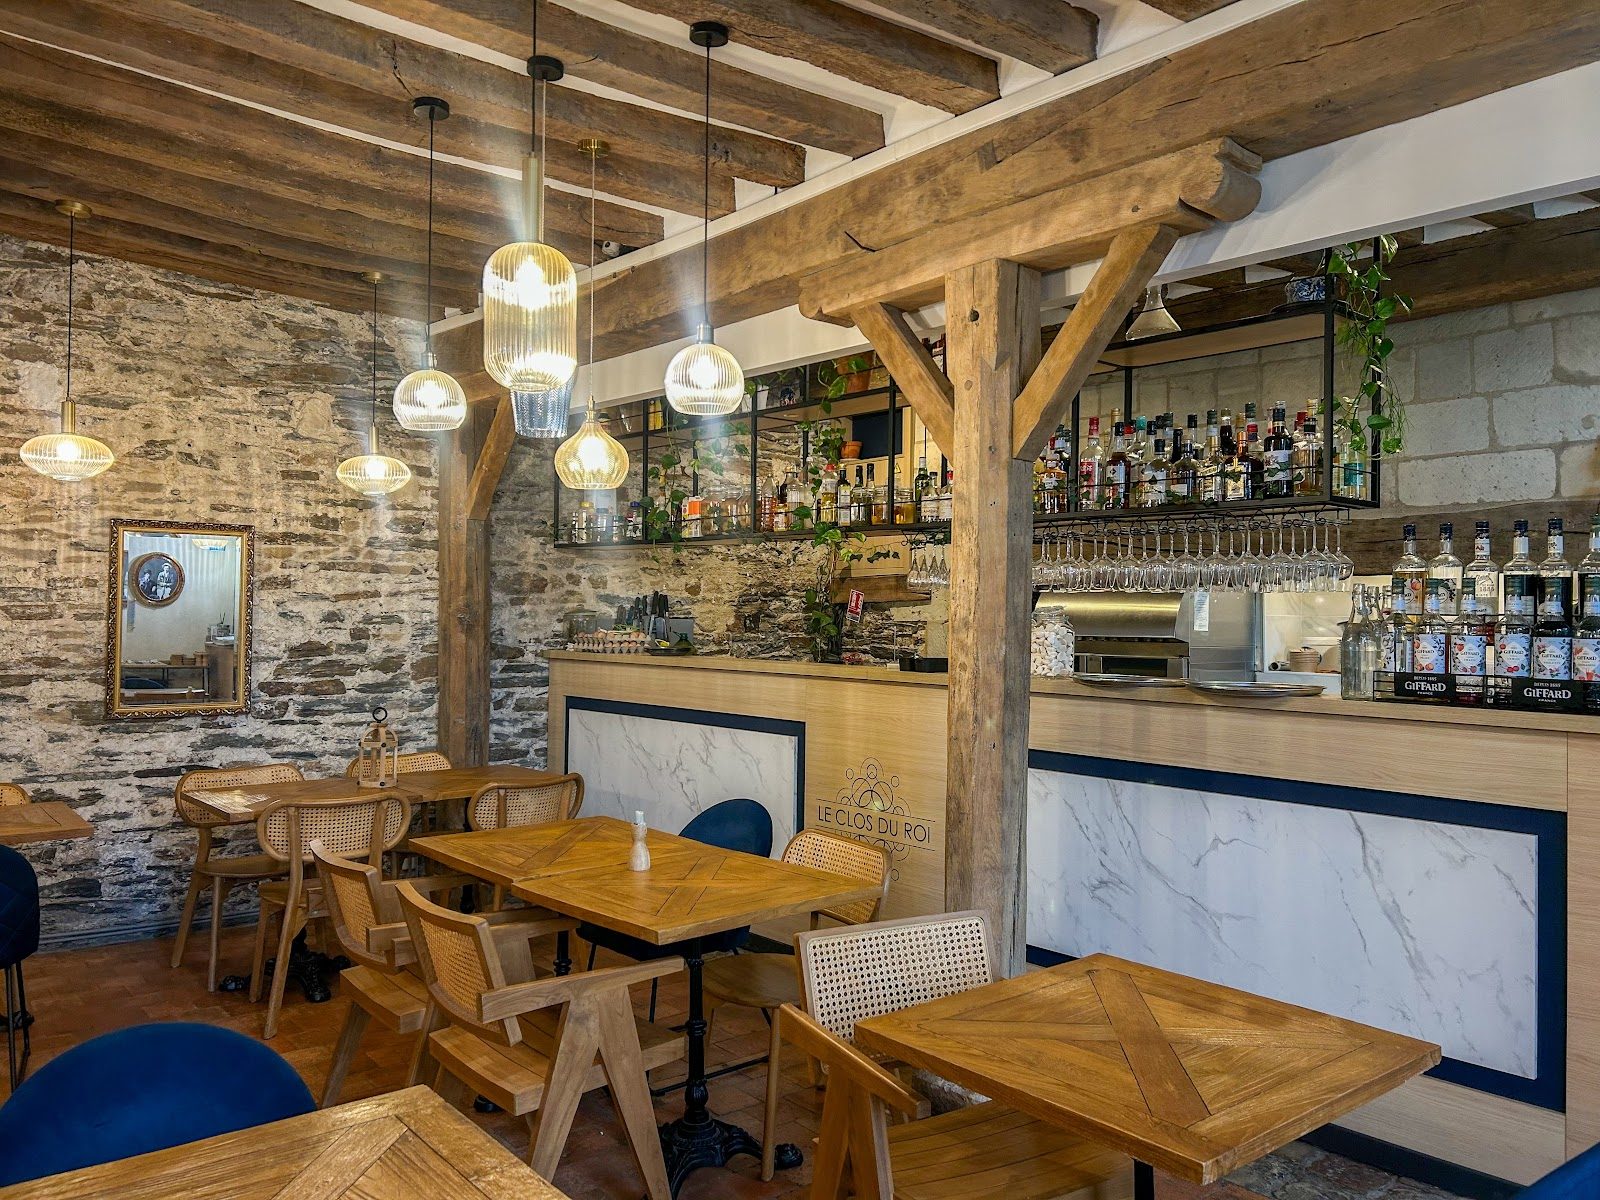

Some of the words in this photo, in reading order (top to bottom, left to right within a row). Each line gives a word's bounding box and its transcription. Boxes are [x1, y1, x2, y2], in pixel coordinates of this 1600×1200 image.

[1404, 680, 1447, 692] GIFFARD
[1523, 687, 1572, 699] GIFFARD
[817, 805, 832, 823] LE
[835, 809, 873, 832] CLOS
[878, 817, 898, 837] DU
[904, 822, 930, 844] ROI
